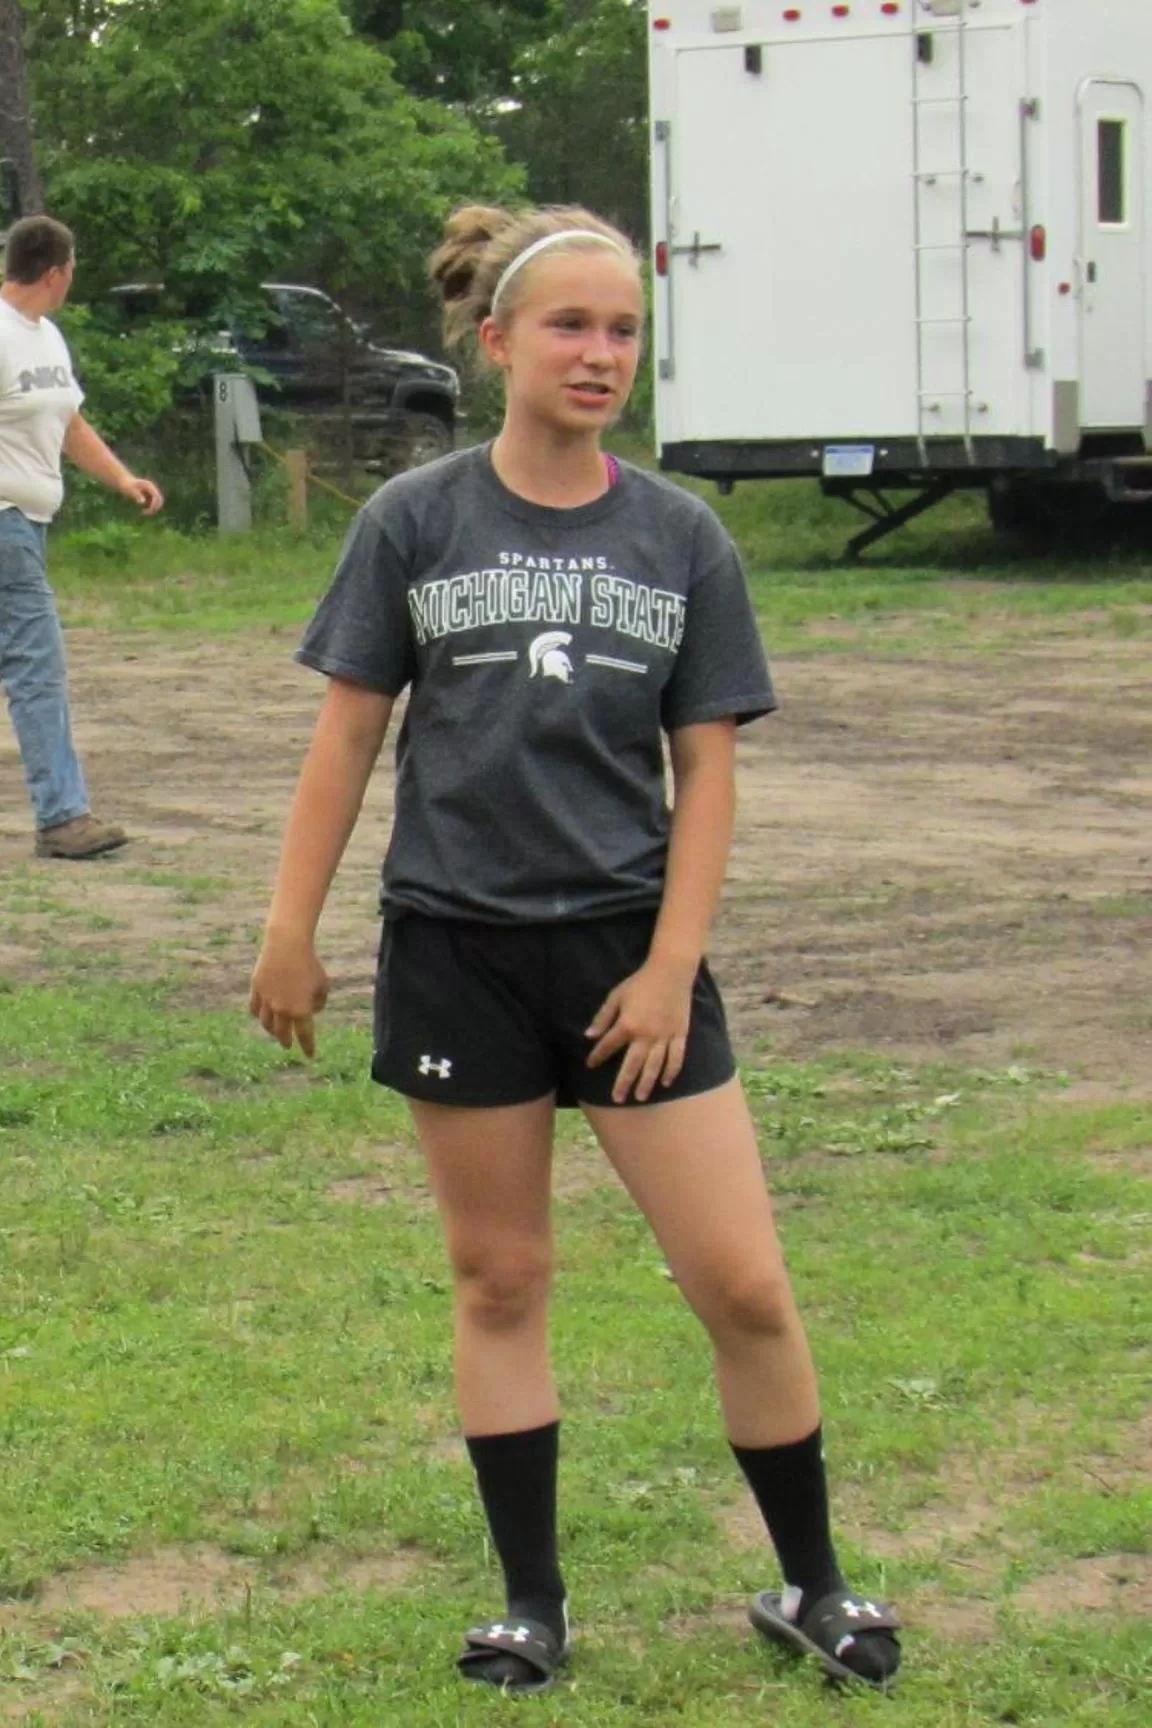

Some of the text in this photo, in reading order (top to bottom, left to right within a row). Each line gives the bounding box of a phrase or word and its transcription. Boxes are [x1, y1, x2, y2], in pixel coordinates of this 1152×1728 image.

[218, 382, 228, 401] 8
[498, 551, 609, 571] SPARTANS
[407, 568, 689, 655] MICHIGAN STATE
